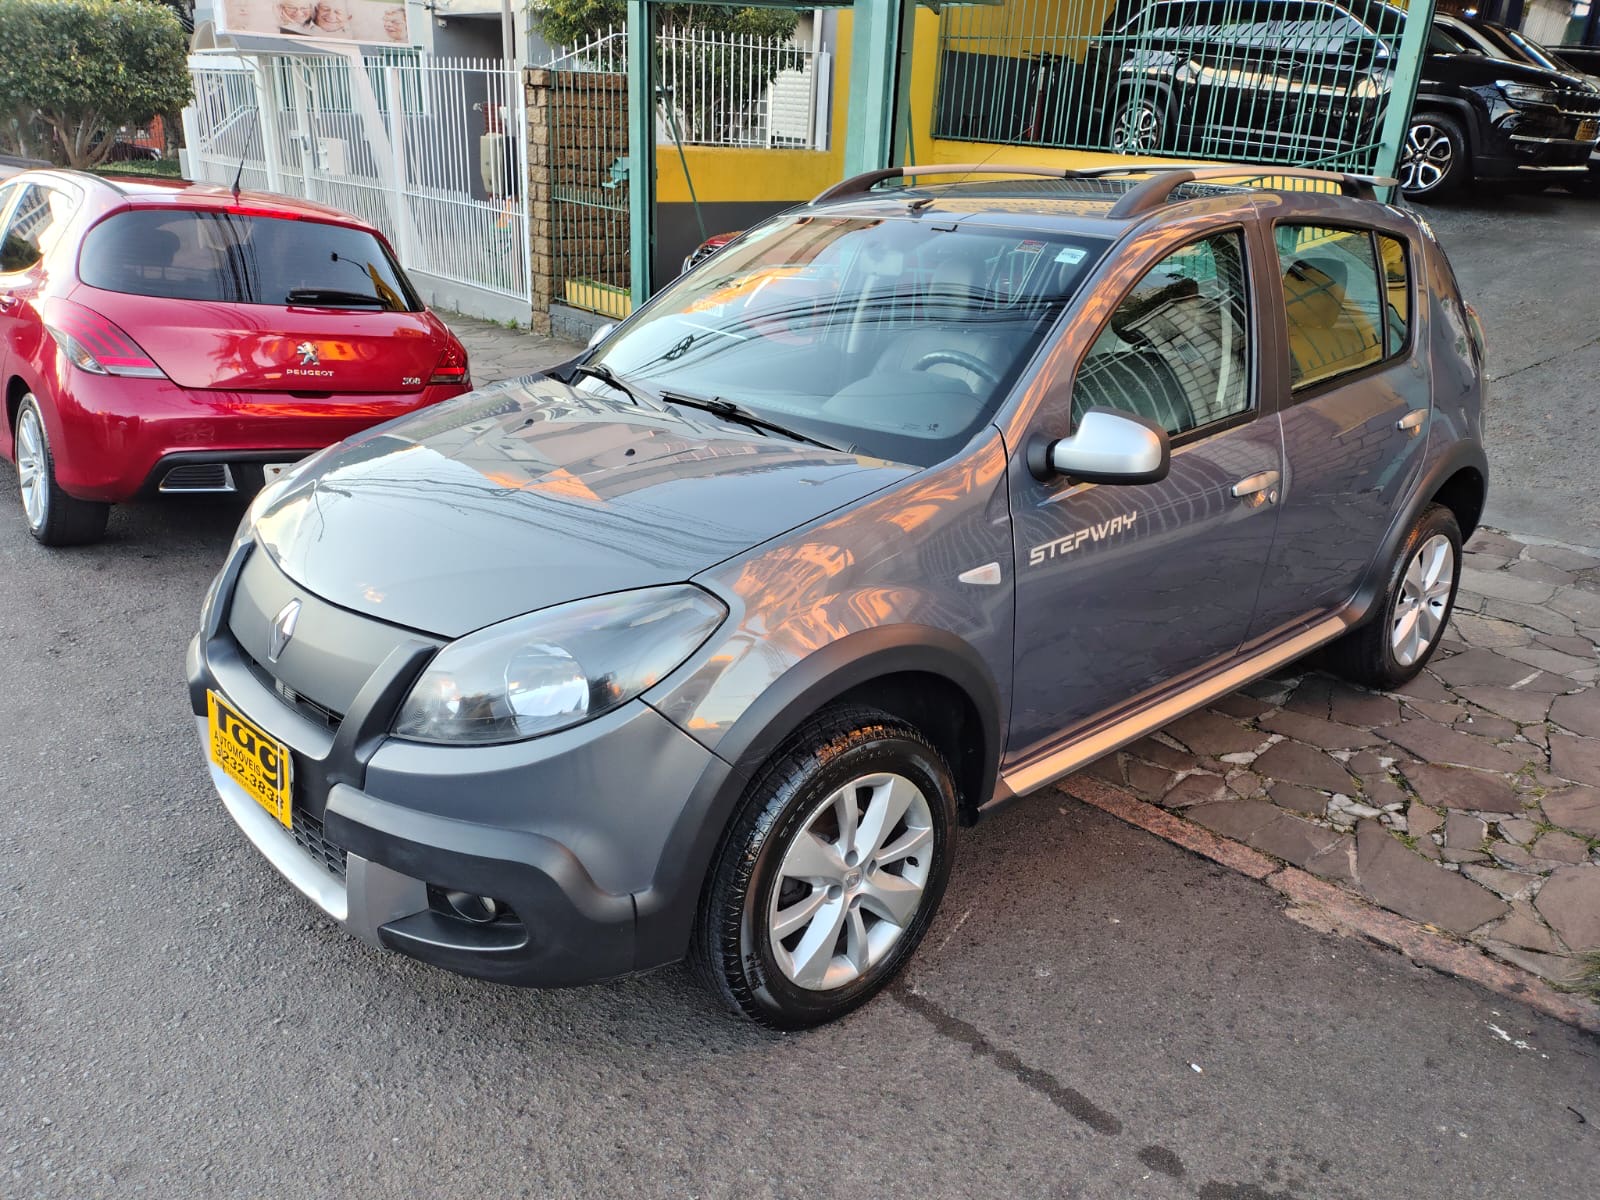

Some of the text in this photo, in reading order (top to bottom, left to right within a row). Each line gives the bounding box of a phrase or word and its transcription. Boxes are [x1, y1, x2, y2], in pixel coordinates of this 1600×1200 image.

[286, 369, 334, 377] PEUGEOT
[402, 377, 421, 385] 308
[1029, 511, 1137, 566] STEPWAY
